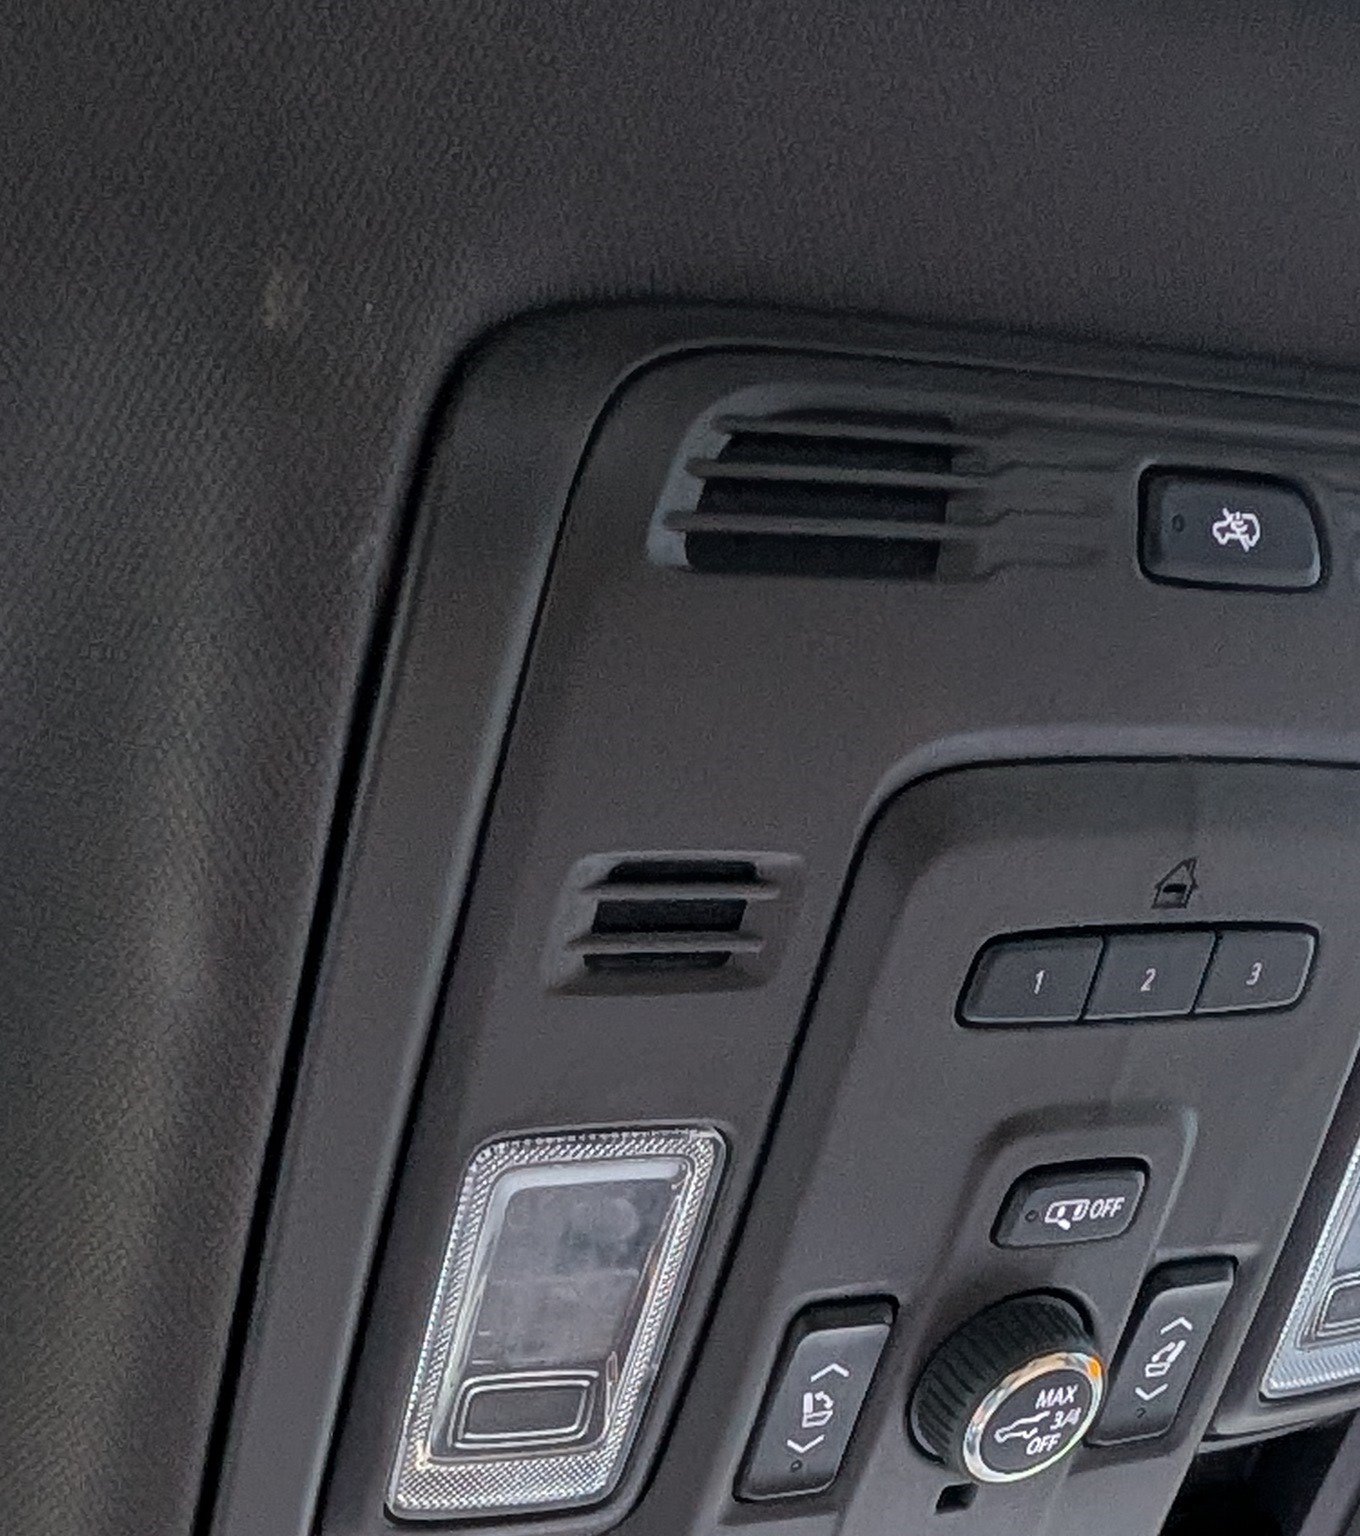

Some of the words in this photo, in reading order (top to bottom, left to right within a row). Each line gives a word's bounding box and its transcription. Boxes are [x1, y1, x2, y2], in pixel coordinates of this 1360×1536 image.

[1035, 970, 1044, 995] 1
[1140, 968, 1156, 992] 2
[1246, 962, 1262, 986] 3
[1089, 1196, 1126, 1219] OFF
[1035, 1384, 1078, 1410] MAX
[1050, 1407, 1081, 1430] 3/4
[1026, 1433, 1061, 1455] OFF
